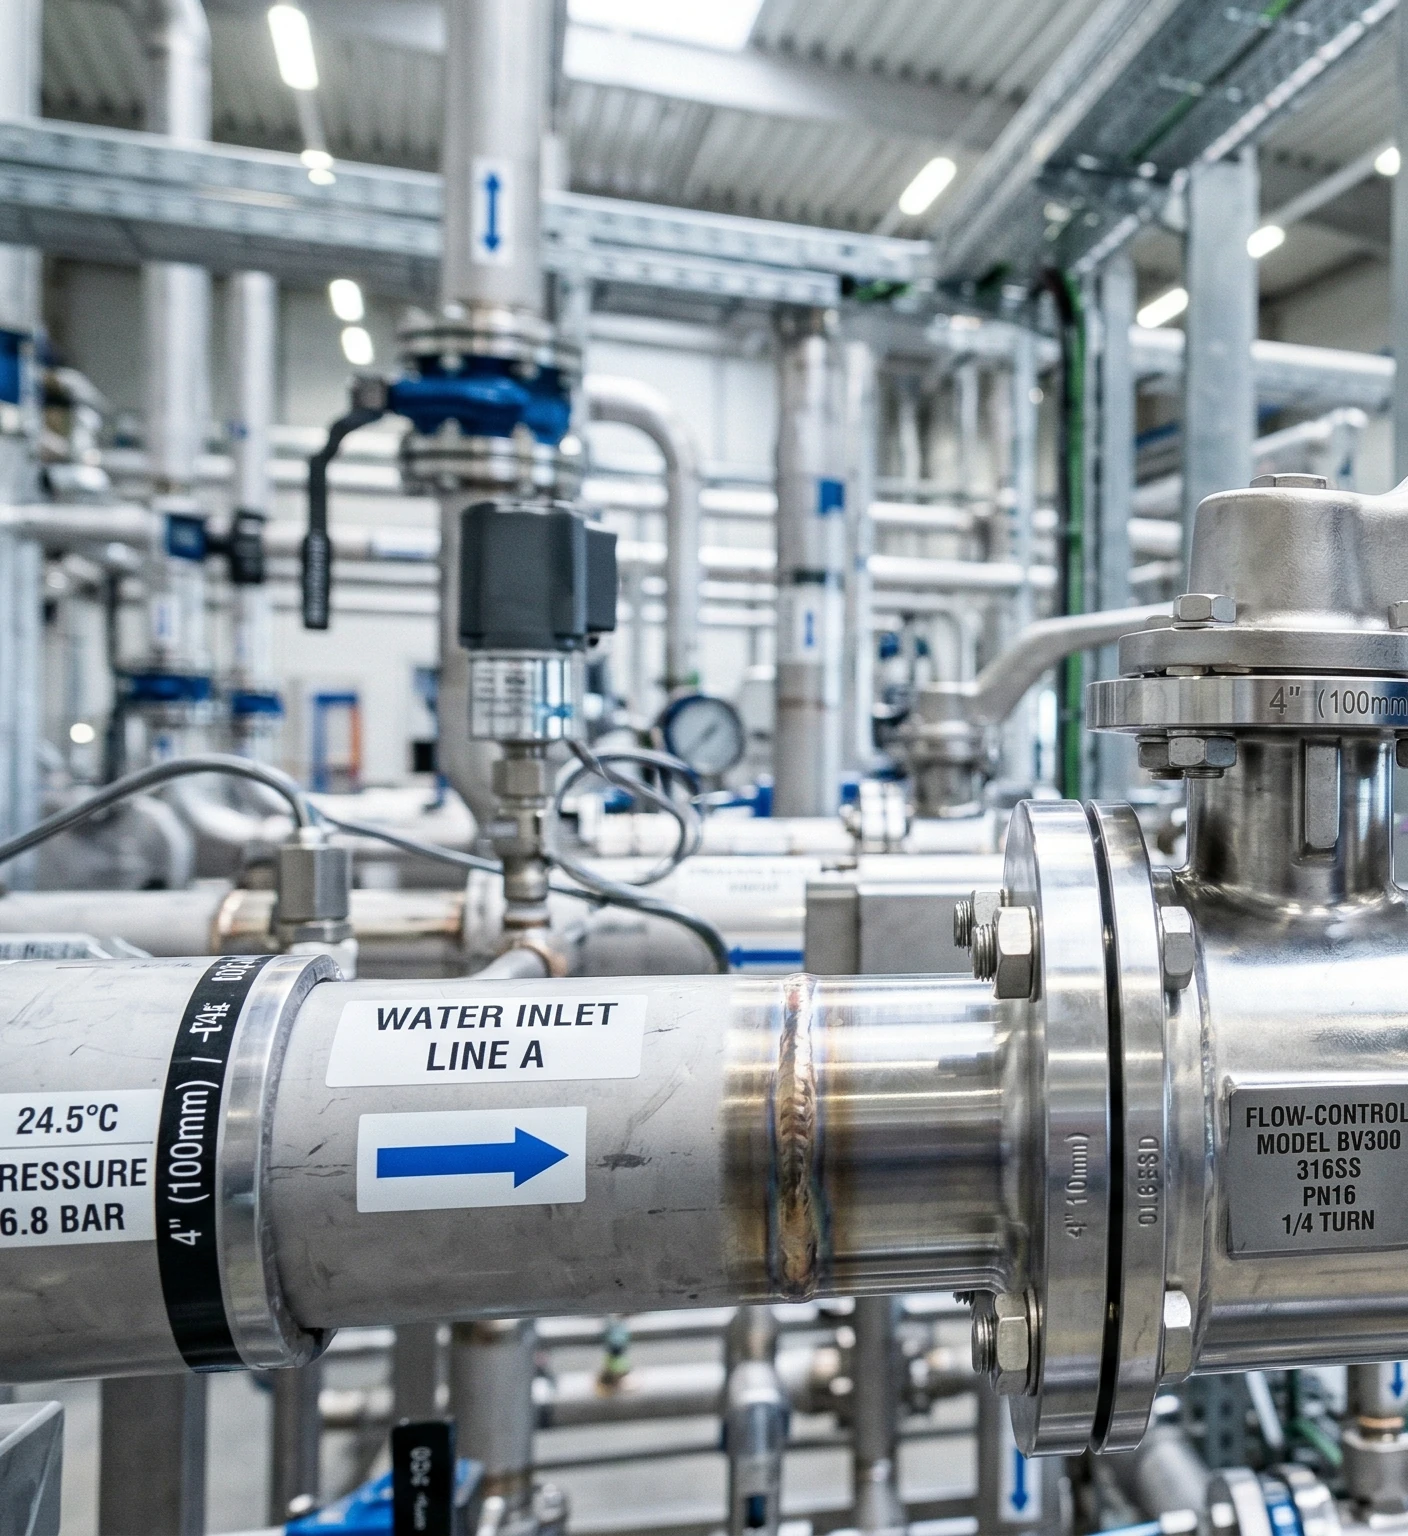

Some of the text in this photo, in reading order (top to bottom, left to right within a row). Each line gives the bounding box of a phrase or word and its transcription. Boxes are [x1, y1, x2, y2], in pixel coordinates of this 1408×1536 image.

[1269, 686, 1301, 715] 4"
[377, 1002, 619, 1031] WATER INLET
[426, 1040, 544, 1071] LINE A
[16, 1103, 119, 1135] 24.5°C
[167, 1080, 220, 1204] (100mm)
[1257, 1129, 1401, 1155] MODEL BV300
[0, 1158, 148, 1192] RESSURE
[1296, 1157, 1361, 1180] 316SS
[1303, 1184, 1356, 1207] PN16
[0, 1203, 125, 1237] 6.8 BAR
[168, 1218, 202, 1246] 4"
[1282, 1210, 1375, 1237] 1/4 TURN
